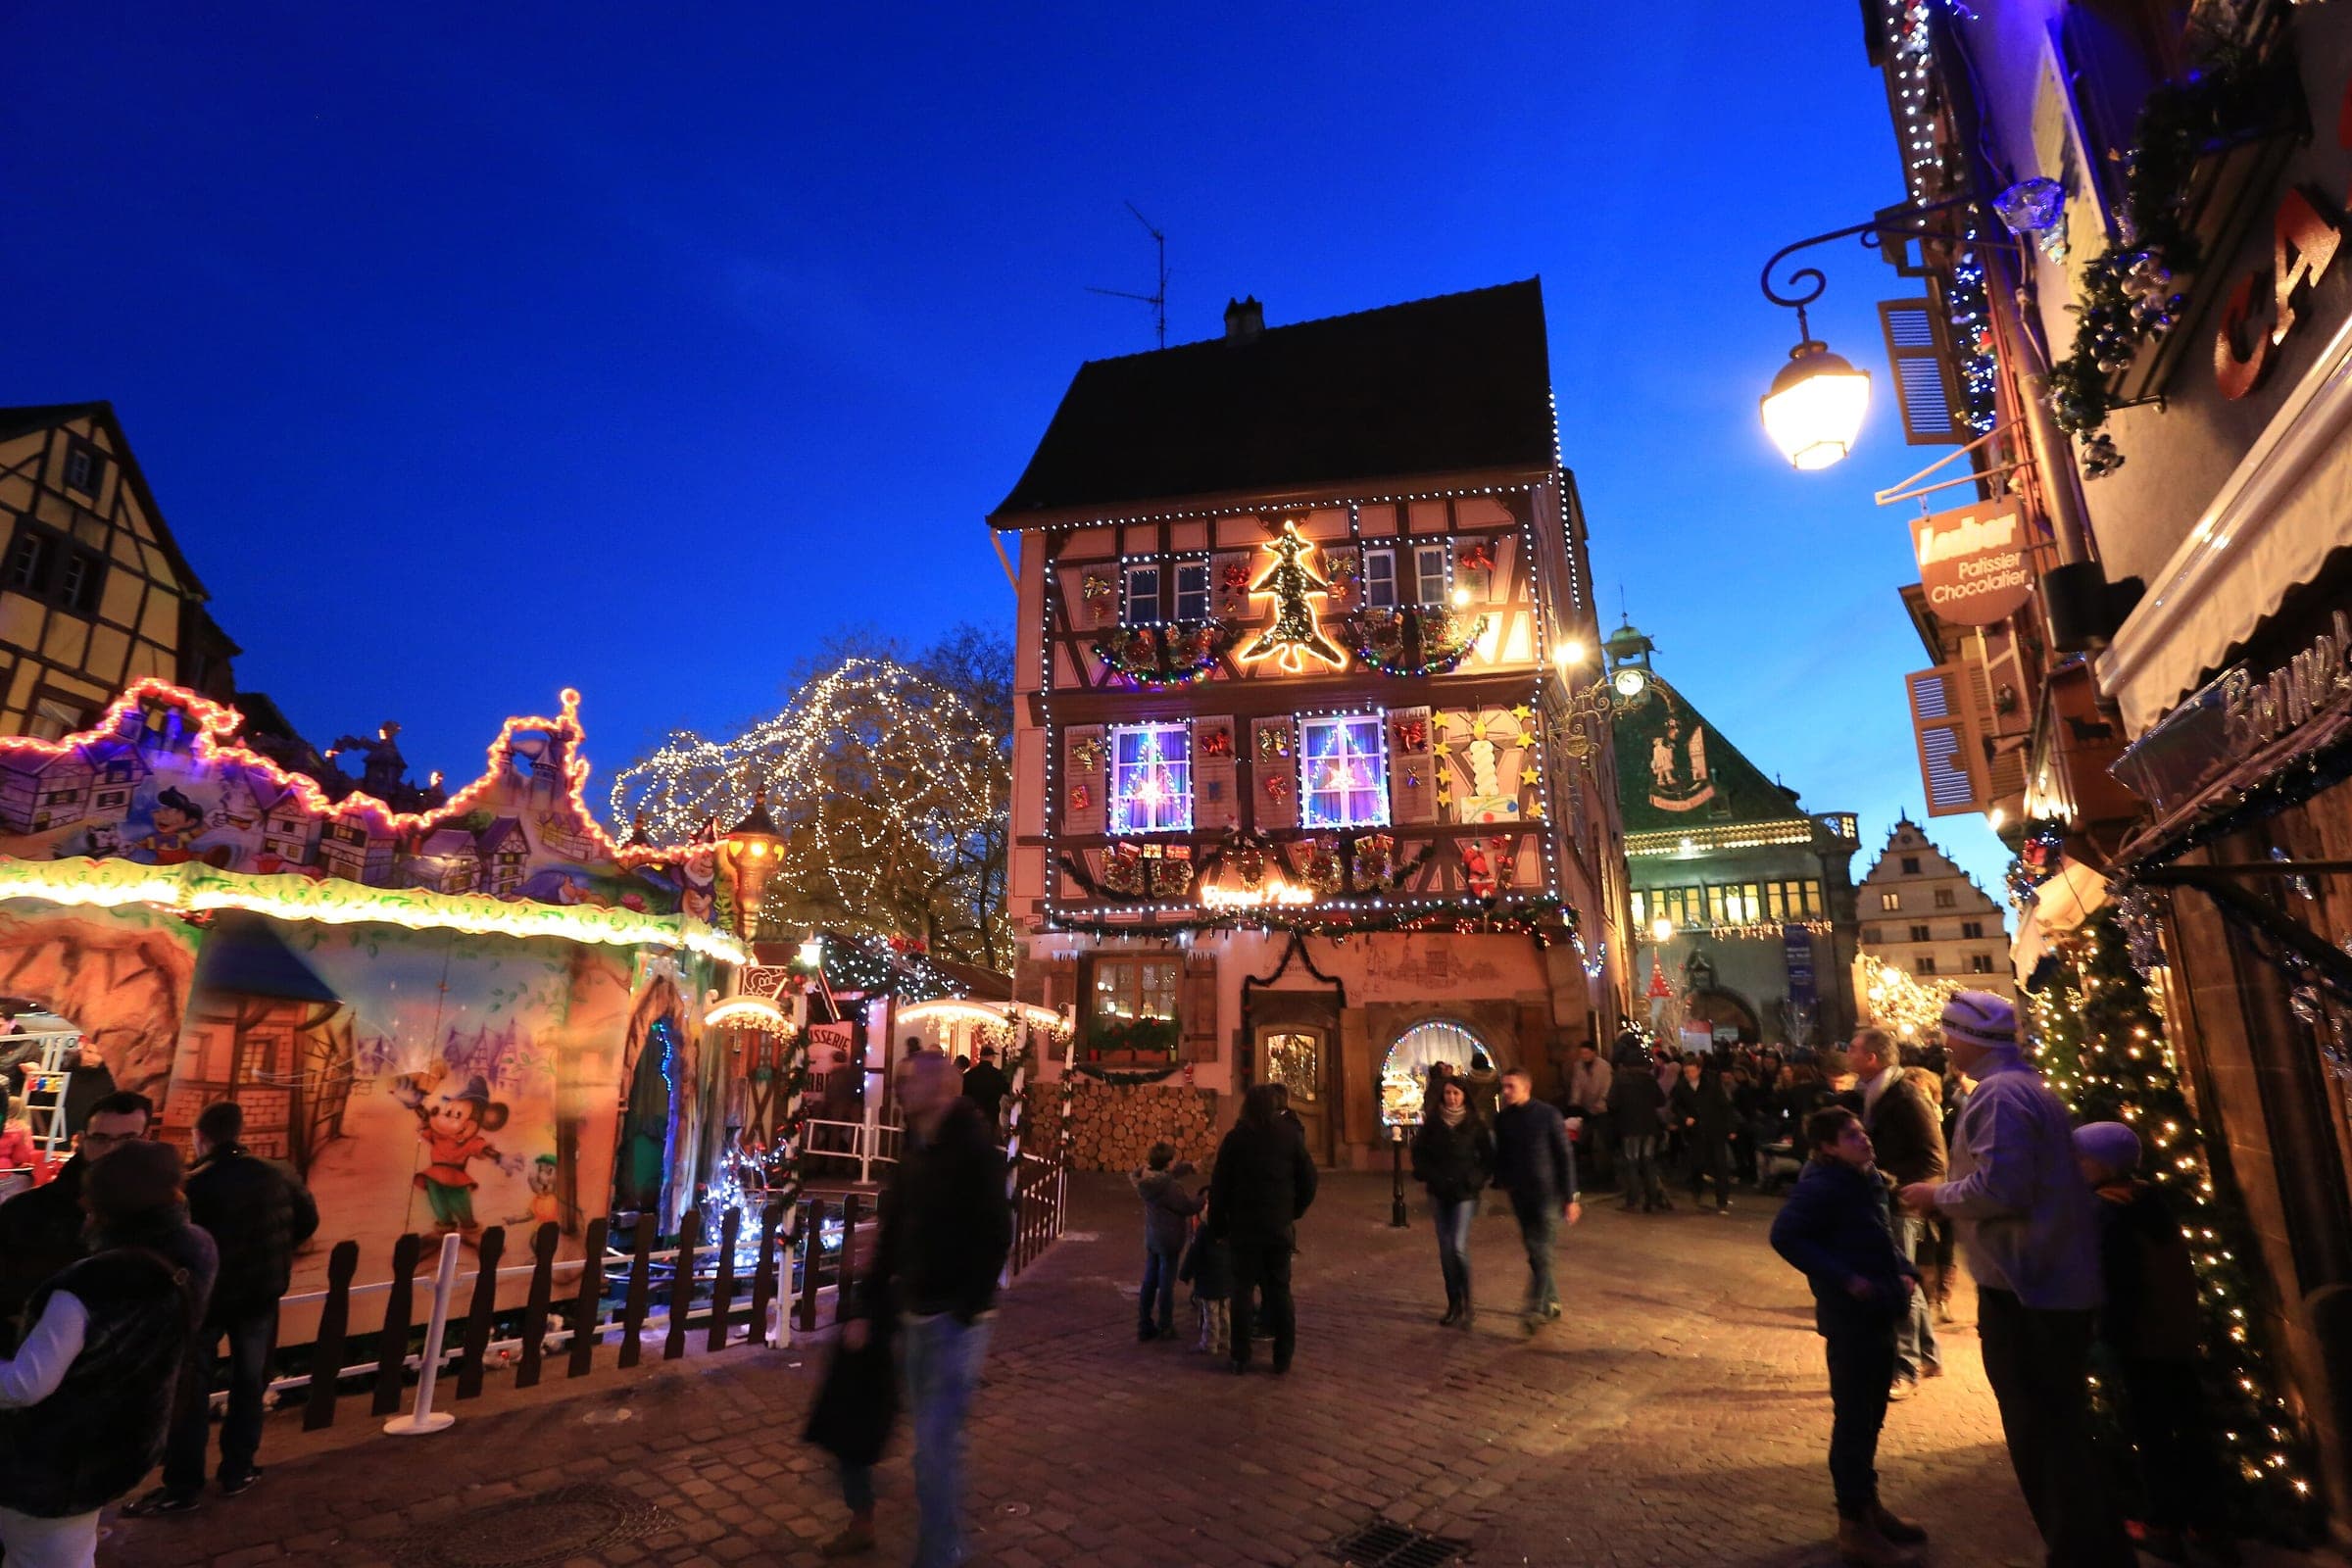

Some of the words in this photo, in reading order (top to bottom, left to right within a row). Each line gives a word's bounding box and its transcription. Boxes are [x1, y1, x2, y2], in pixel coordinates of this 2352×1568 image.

[2214, 172, 2352, 401] CA
[1959, 552, 2022, 580] Patissier
[1932, 569, 2028, 604] Chocolatier
[809, 1029, 851, 1052] ISSERIE
